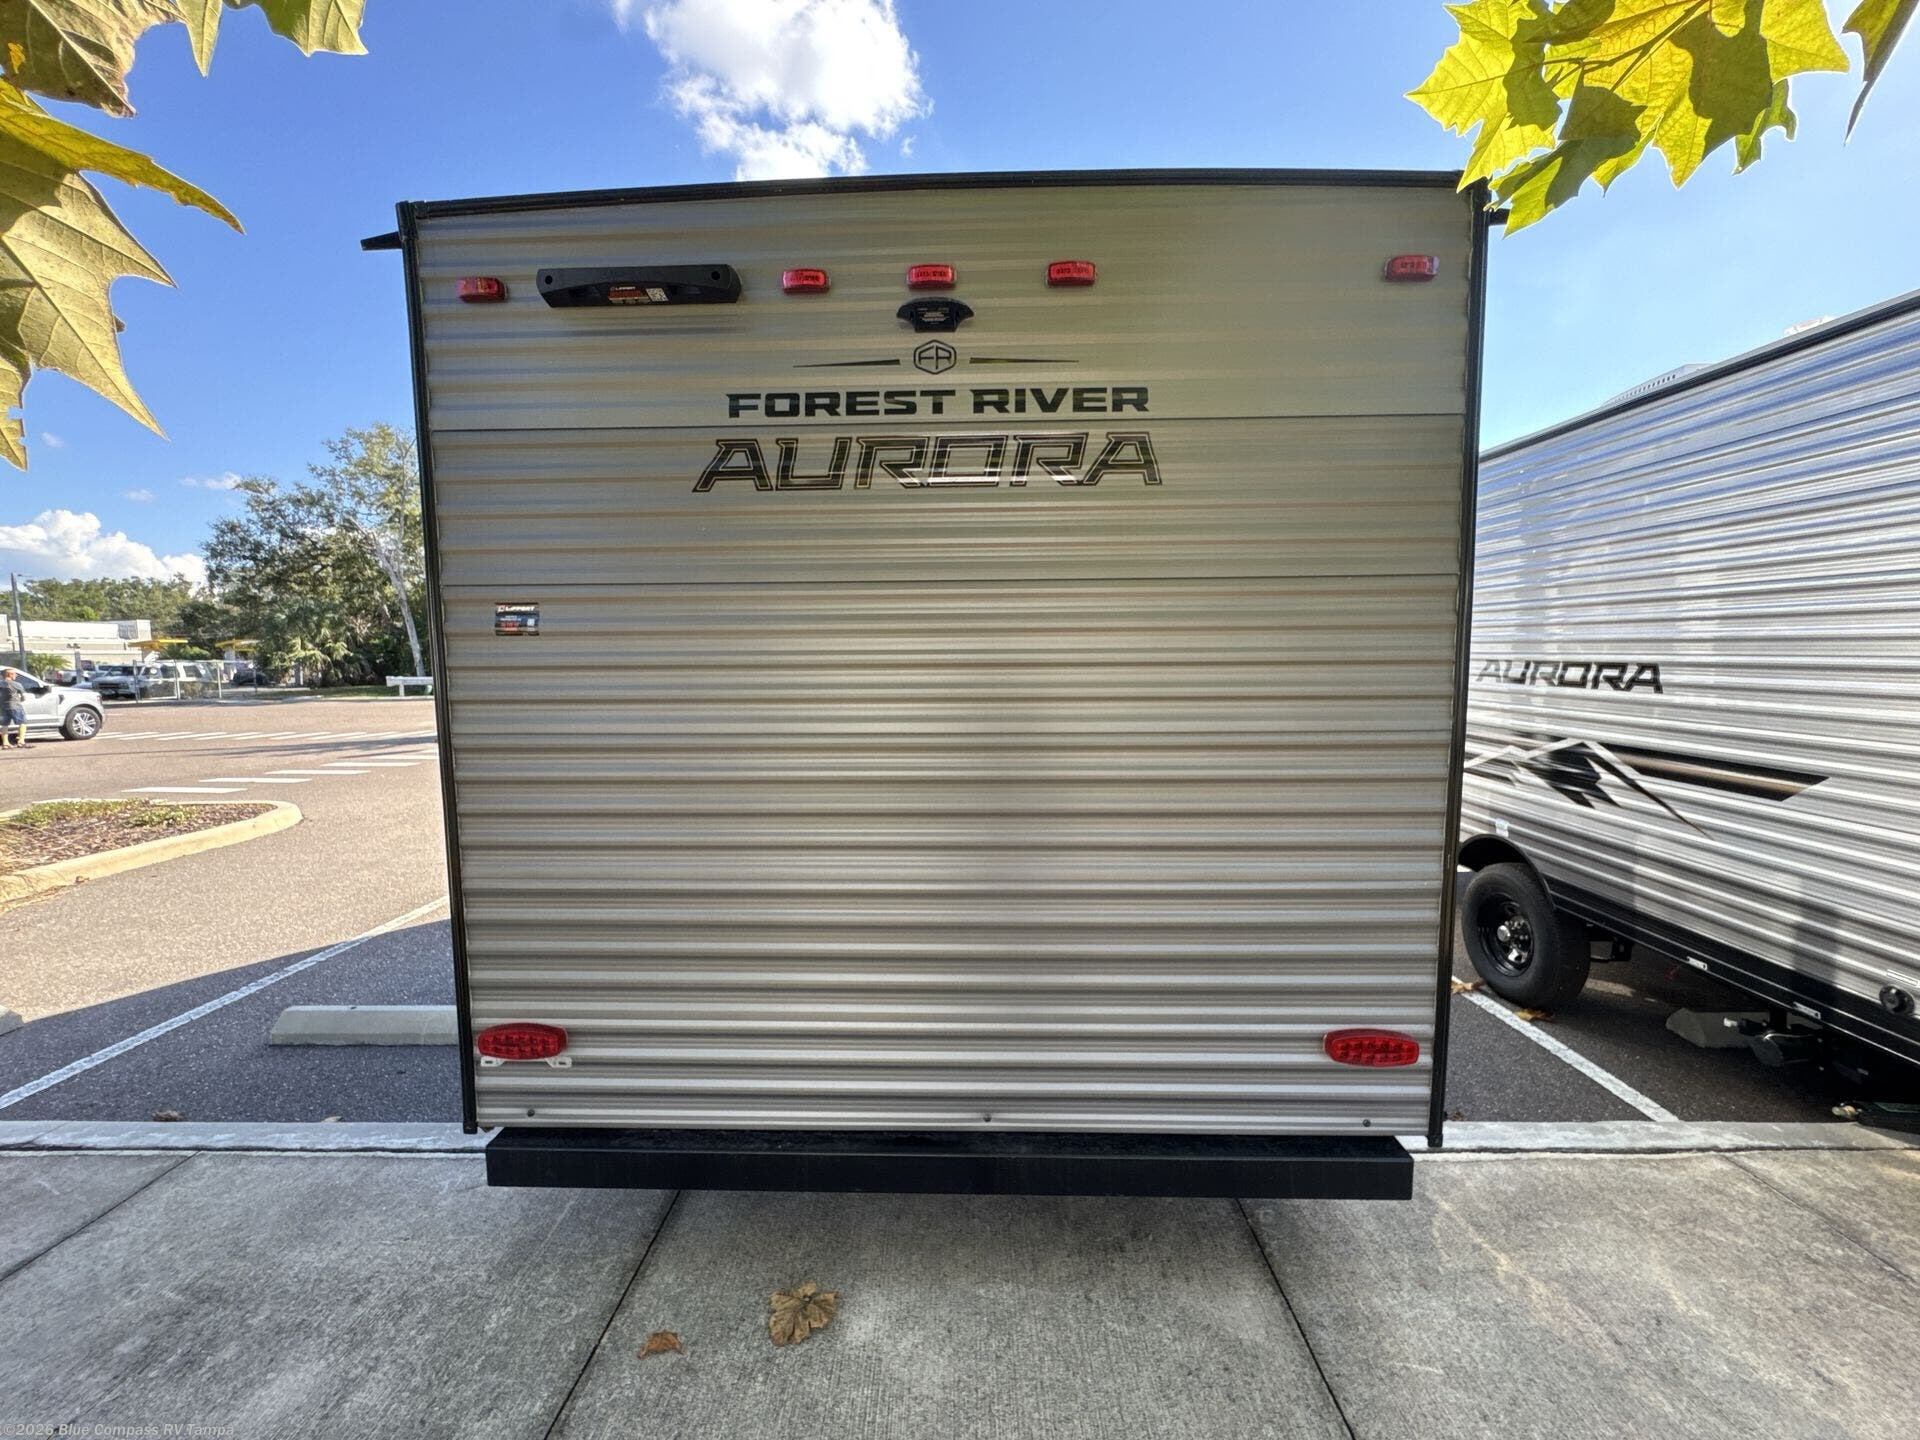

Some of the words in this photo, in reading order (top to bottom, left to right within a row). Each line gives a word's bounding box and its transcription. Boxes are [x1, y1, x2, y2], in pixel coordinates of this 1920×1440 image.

[726, 390, 956, 418] FOREST
[969, 386, 1150, 414] RIVER
[692, 431, 1162, 492] AURORA
[1476, 659, 1663, 694] AURORA
